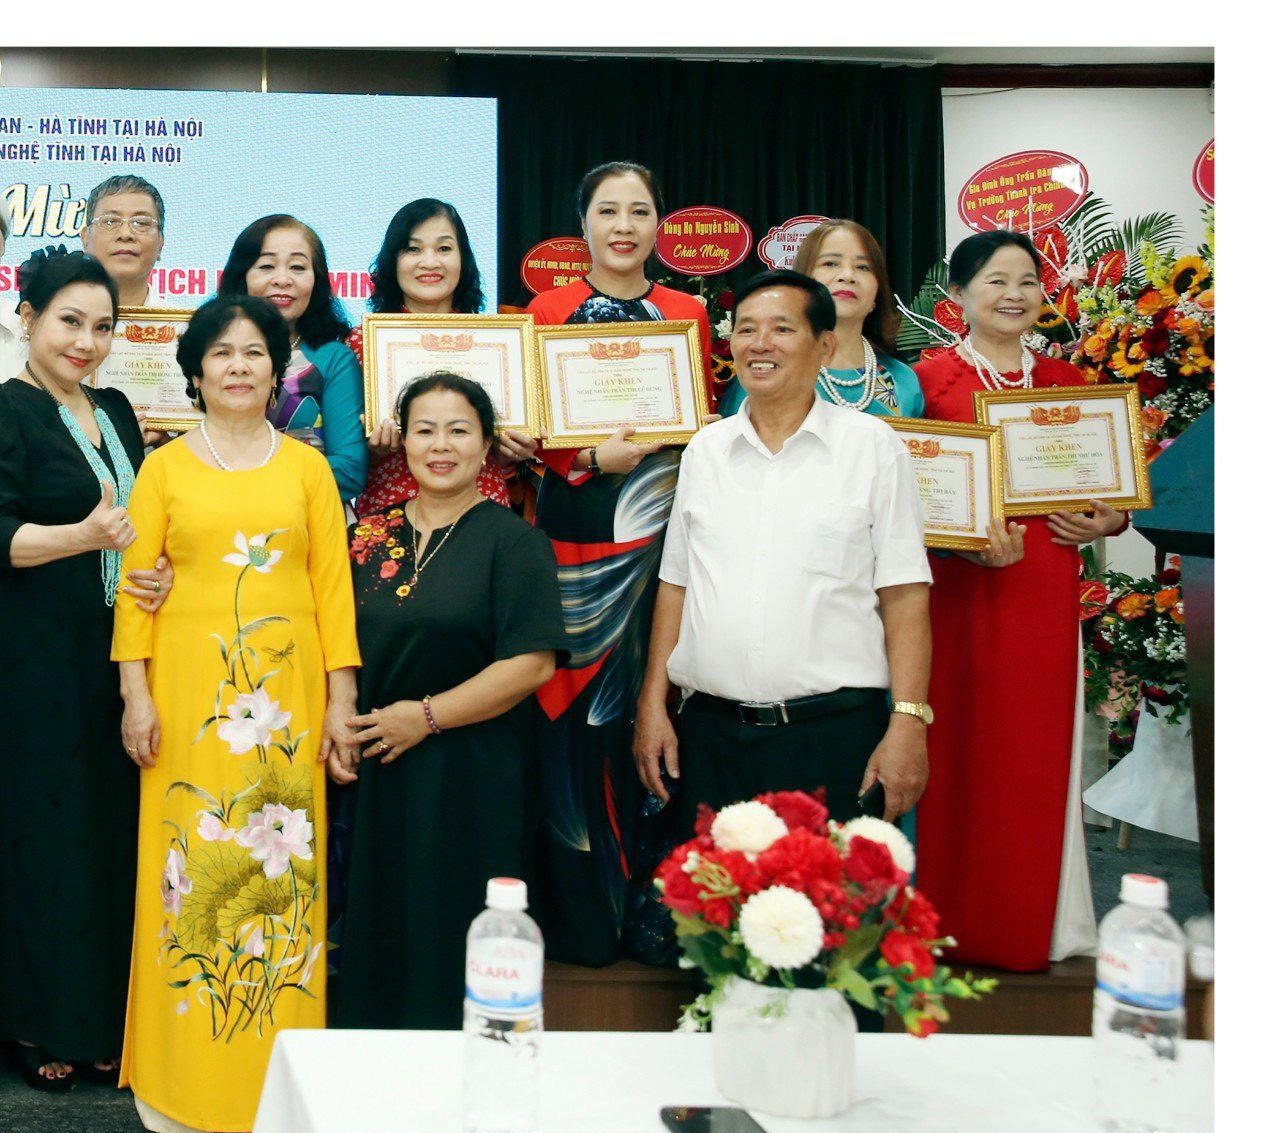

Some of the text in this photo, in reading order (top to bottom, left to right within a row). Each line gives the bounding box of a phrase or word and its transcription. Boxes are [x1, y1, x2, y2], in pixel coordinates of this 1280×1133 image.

[39, 114, 62, 135] HÀ
[68, 115, 107, 135] TĨNH
[113, 119, 139, 139] TẠI
[145, 117, 167, 137] HÀ
[173, 118, 203, 141] NỘI
[46, 141, 85, 161] TĨNH
[91, 145, 117, 165] TẠI
[123, 143, 146, 162] HÀ
[152, 143, 181, 166] NỘI
[2, 183, 88, 238] Mừ
[684, 222, 693, 237] Họ
[724, 221, 740, 234] Sinh
[673, 243, 697, 258] Chúc
